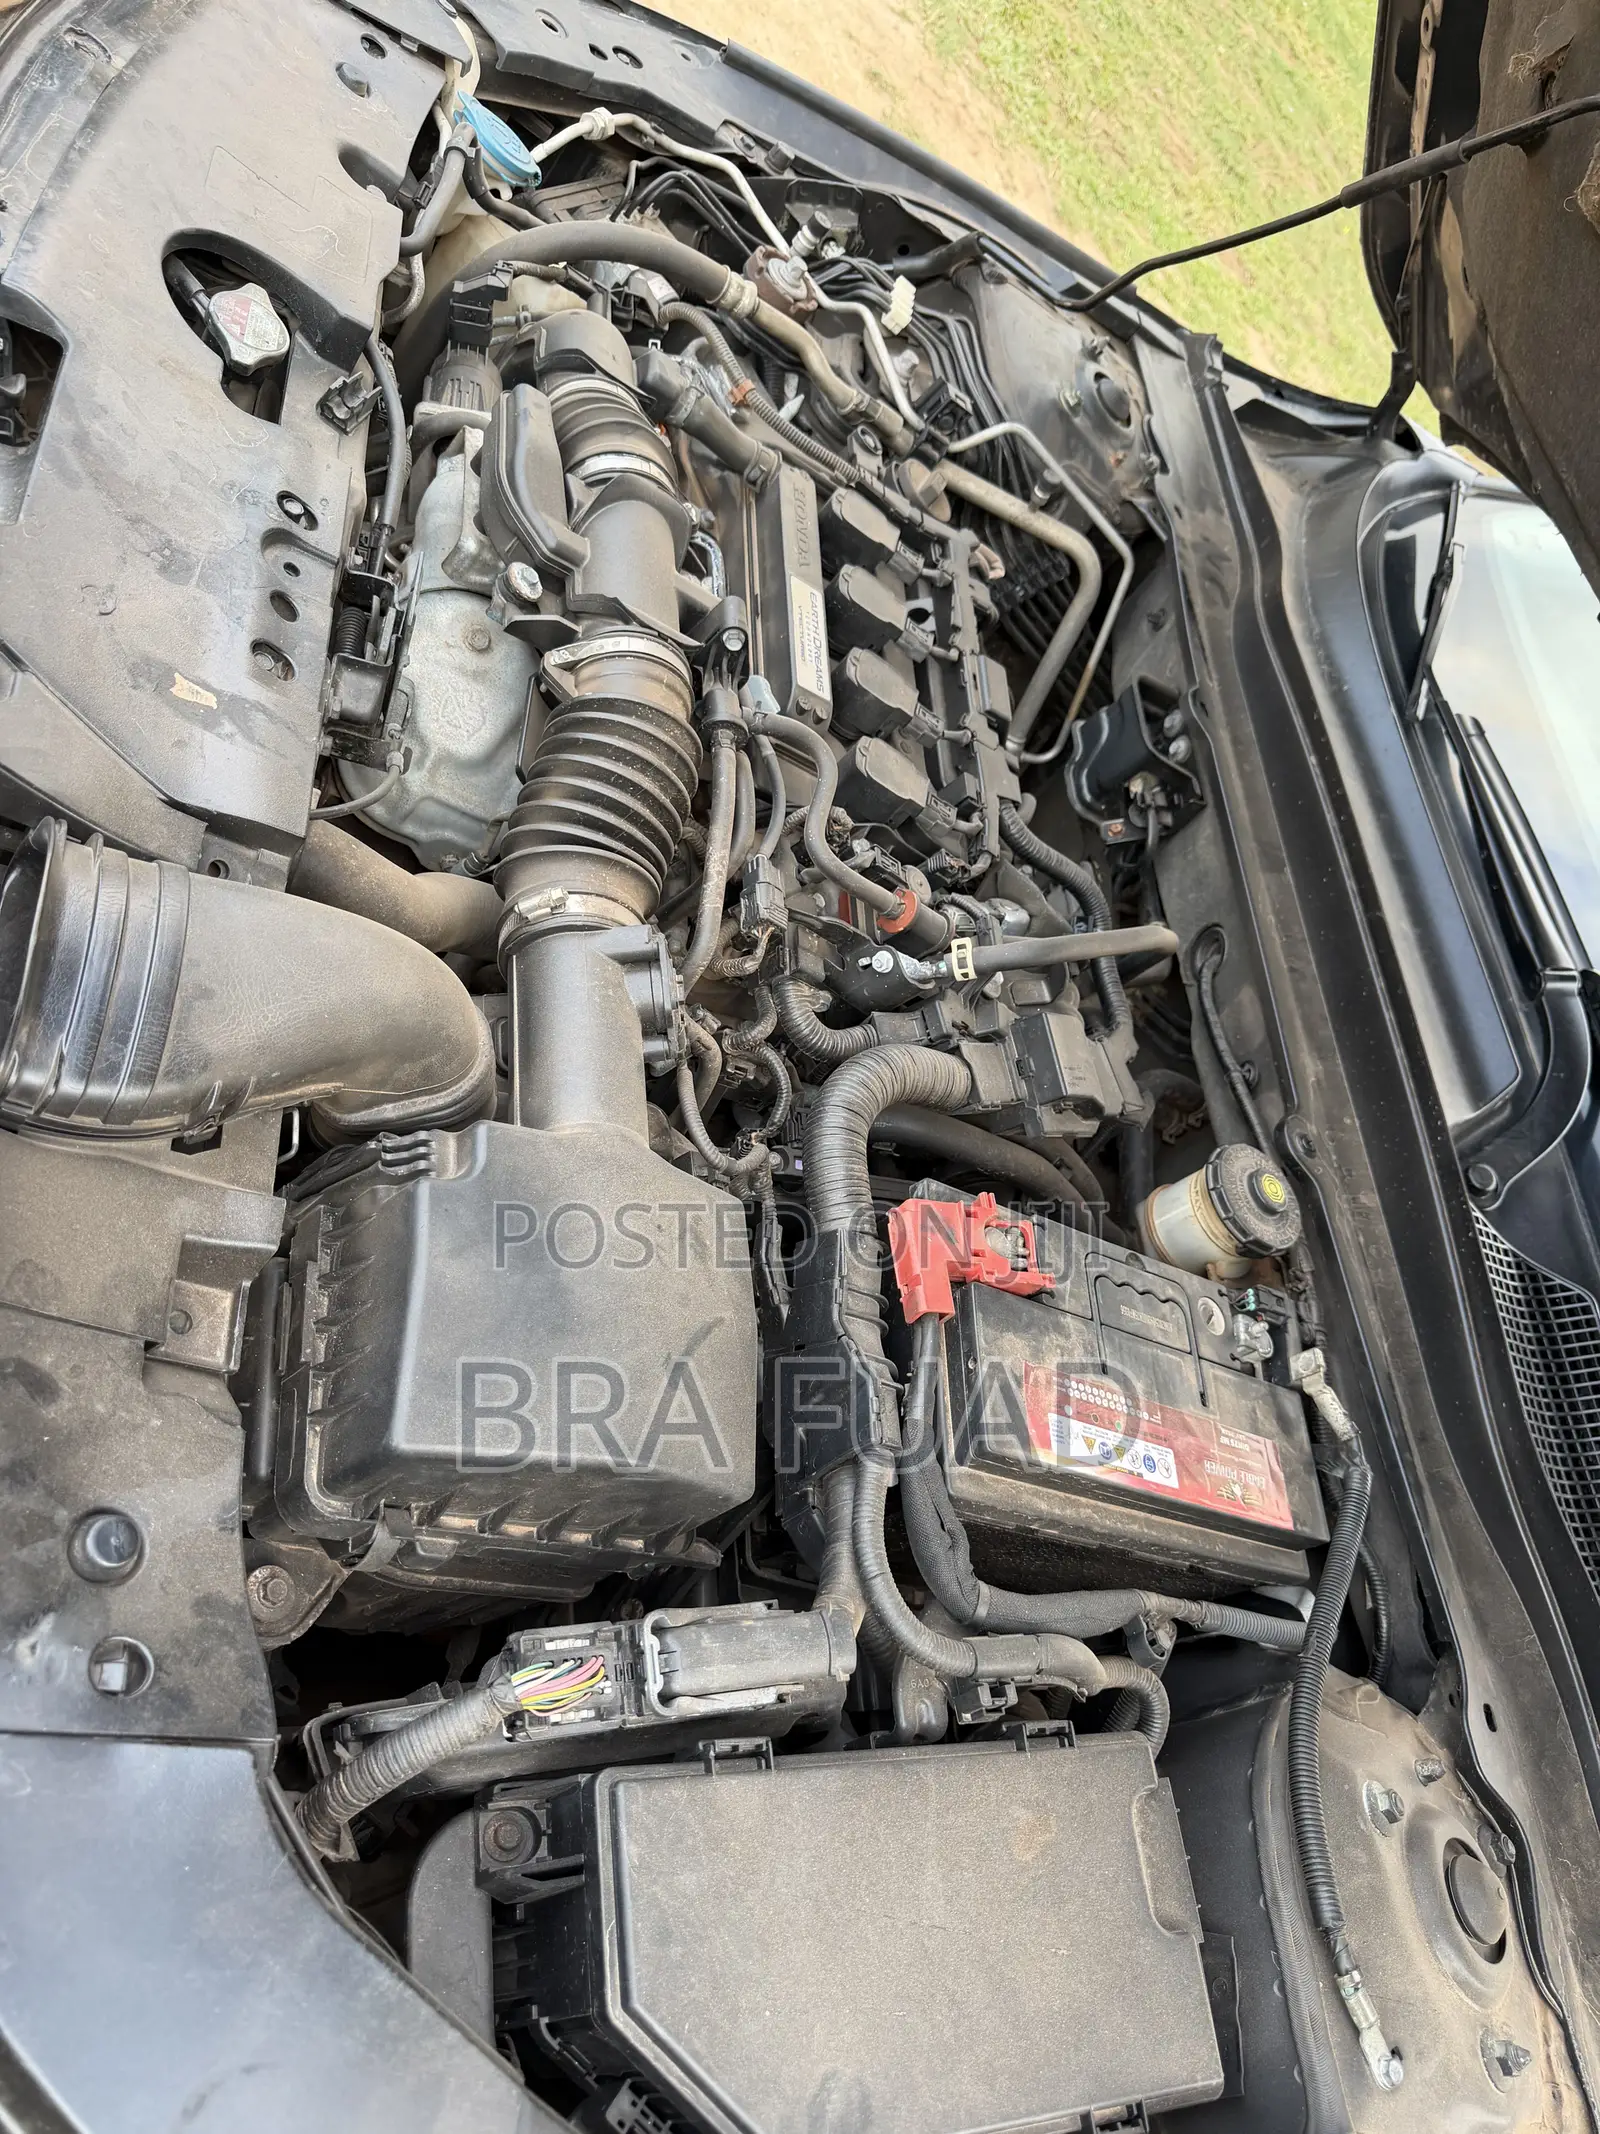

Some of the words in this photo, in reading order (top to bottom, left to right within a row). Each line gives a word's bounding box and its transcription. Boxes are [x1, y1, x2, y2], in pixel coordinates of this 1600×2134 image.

[793, 481, 811, 567] HONDA
[810, 592, 820, 636] EARTH
[813, 637, 825, 694] DREAMS
[1204, 1460, 1239, 1480] POWER
